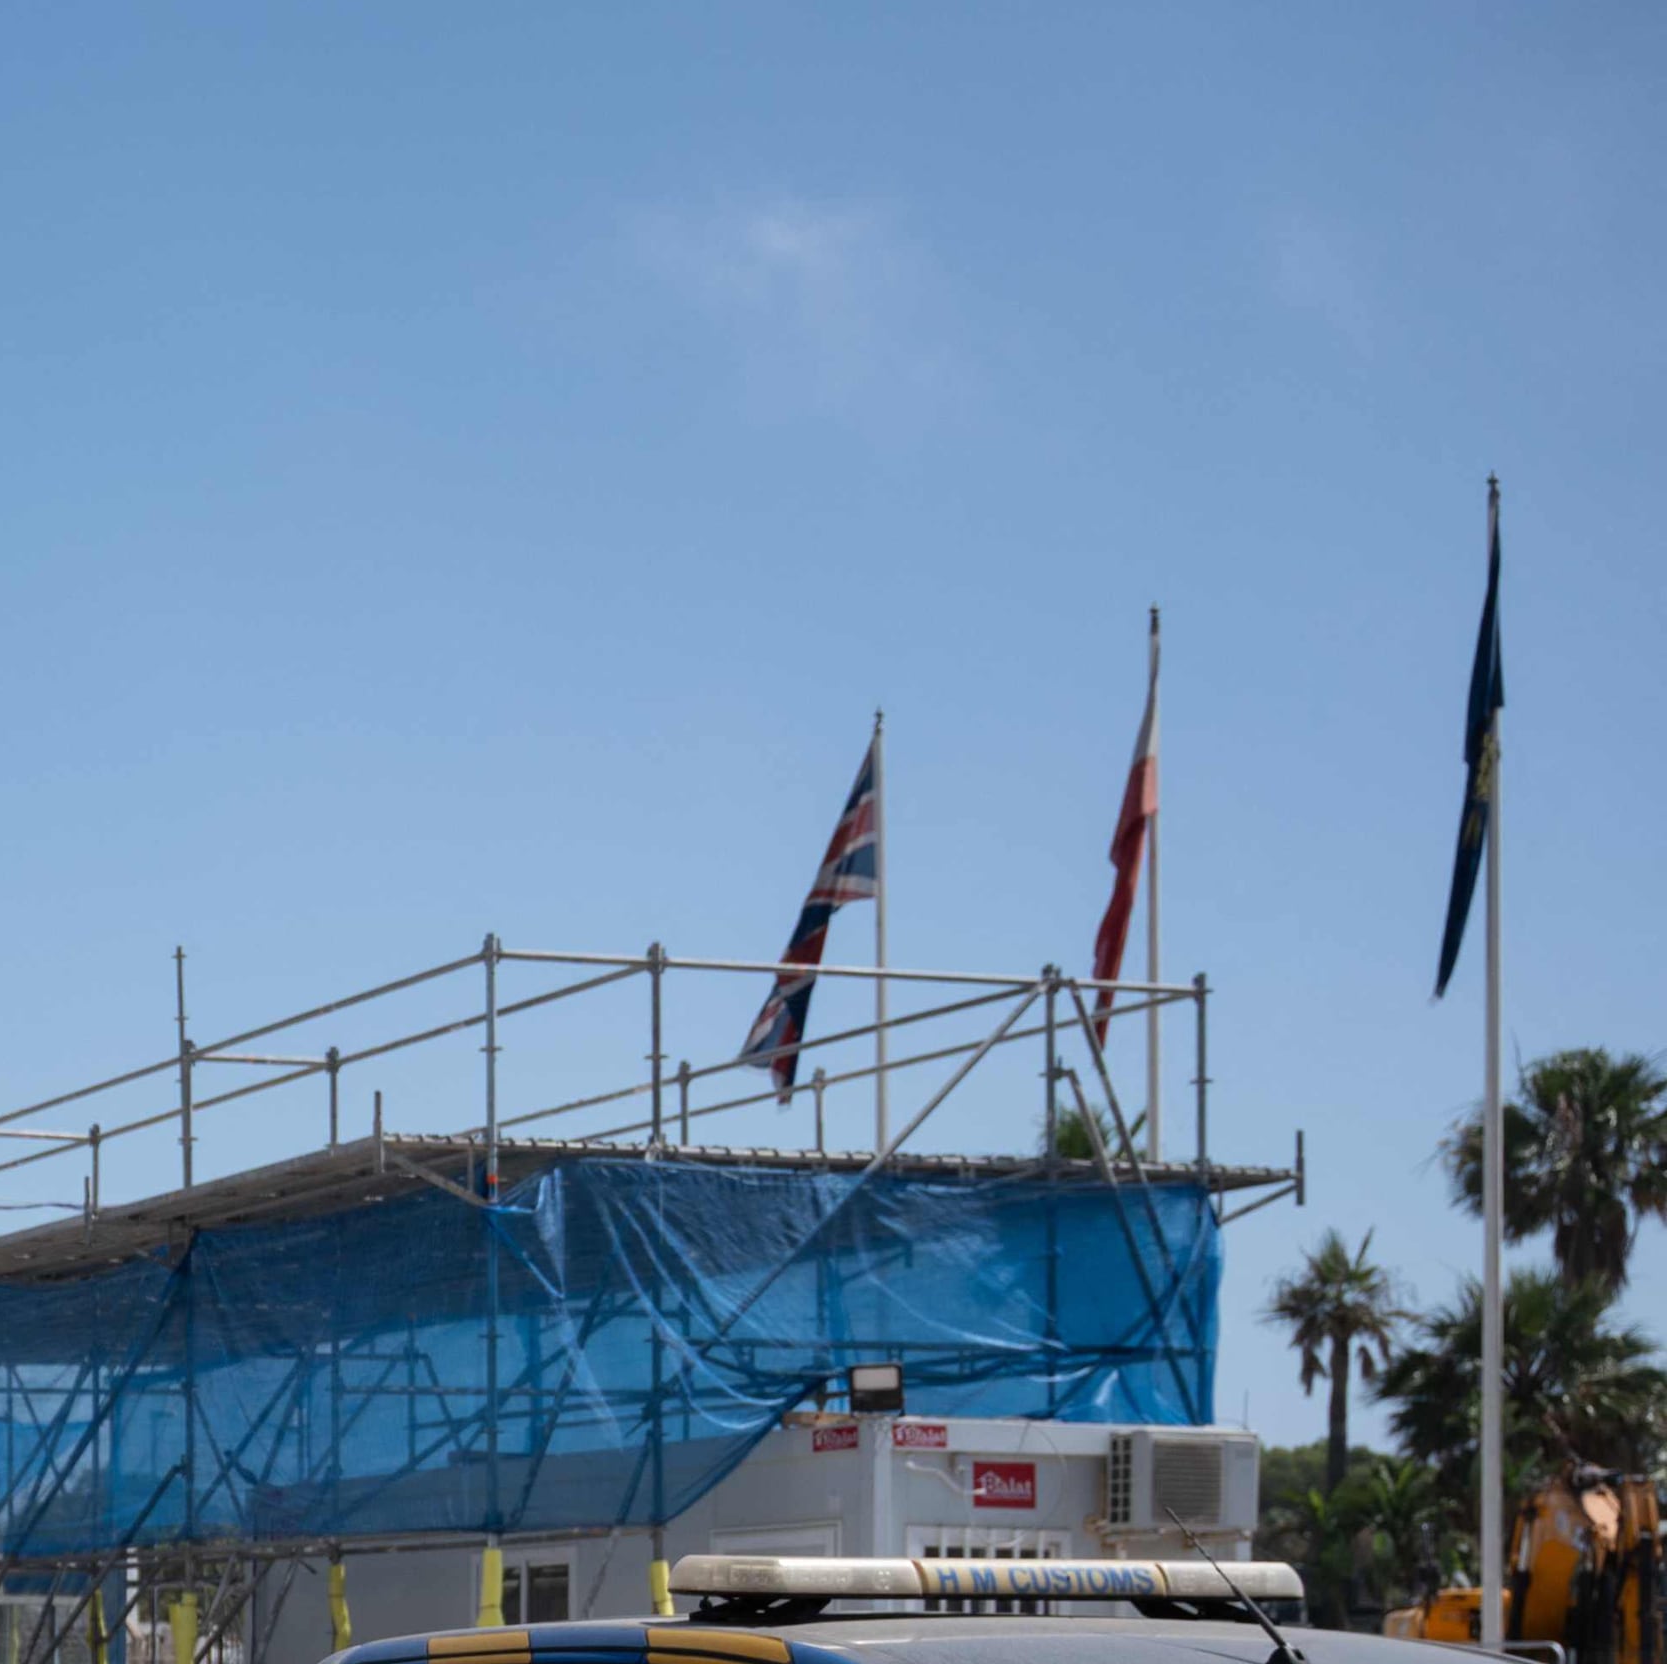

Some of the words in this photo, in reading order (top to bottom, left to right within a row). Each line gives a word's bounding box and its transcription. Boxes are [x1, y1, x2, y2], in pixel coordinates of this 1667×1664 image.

[938, 1568, 960, 1594] H
[972, 1568, 997, 1594] M
[1009, 1567, 1155, 1594] CUSTOMS
